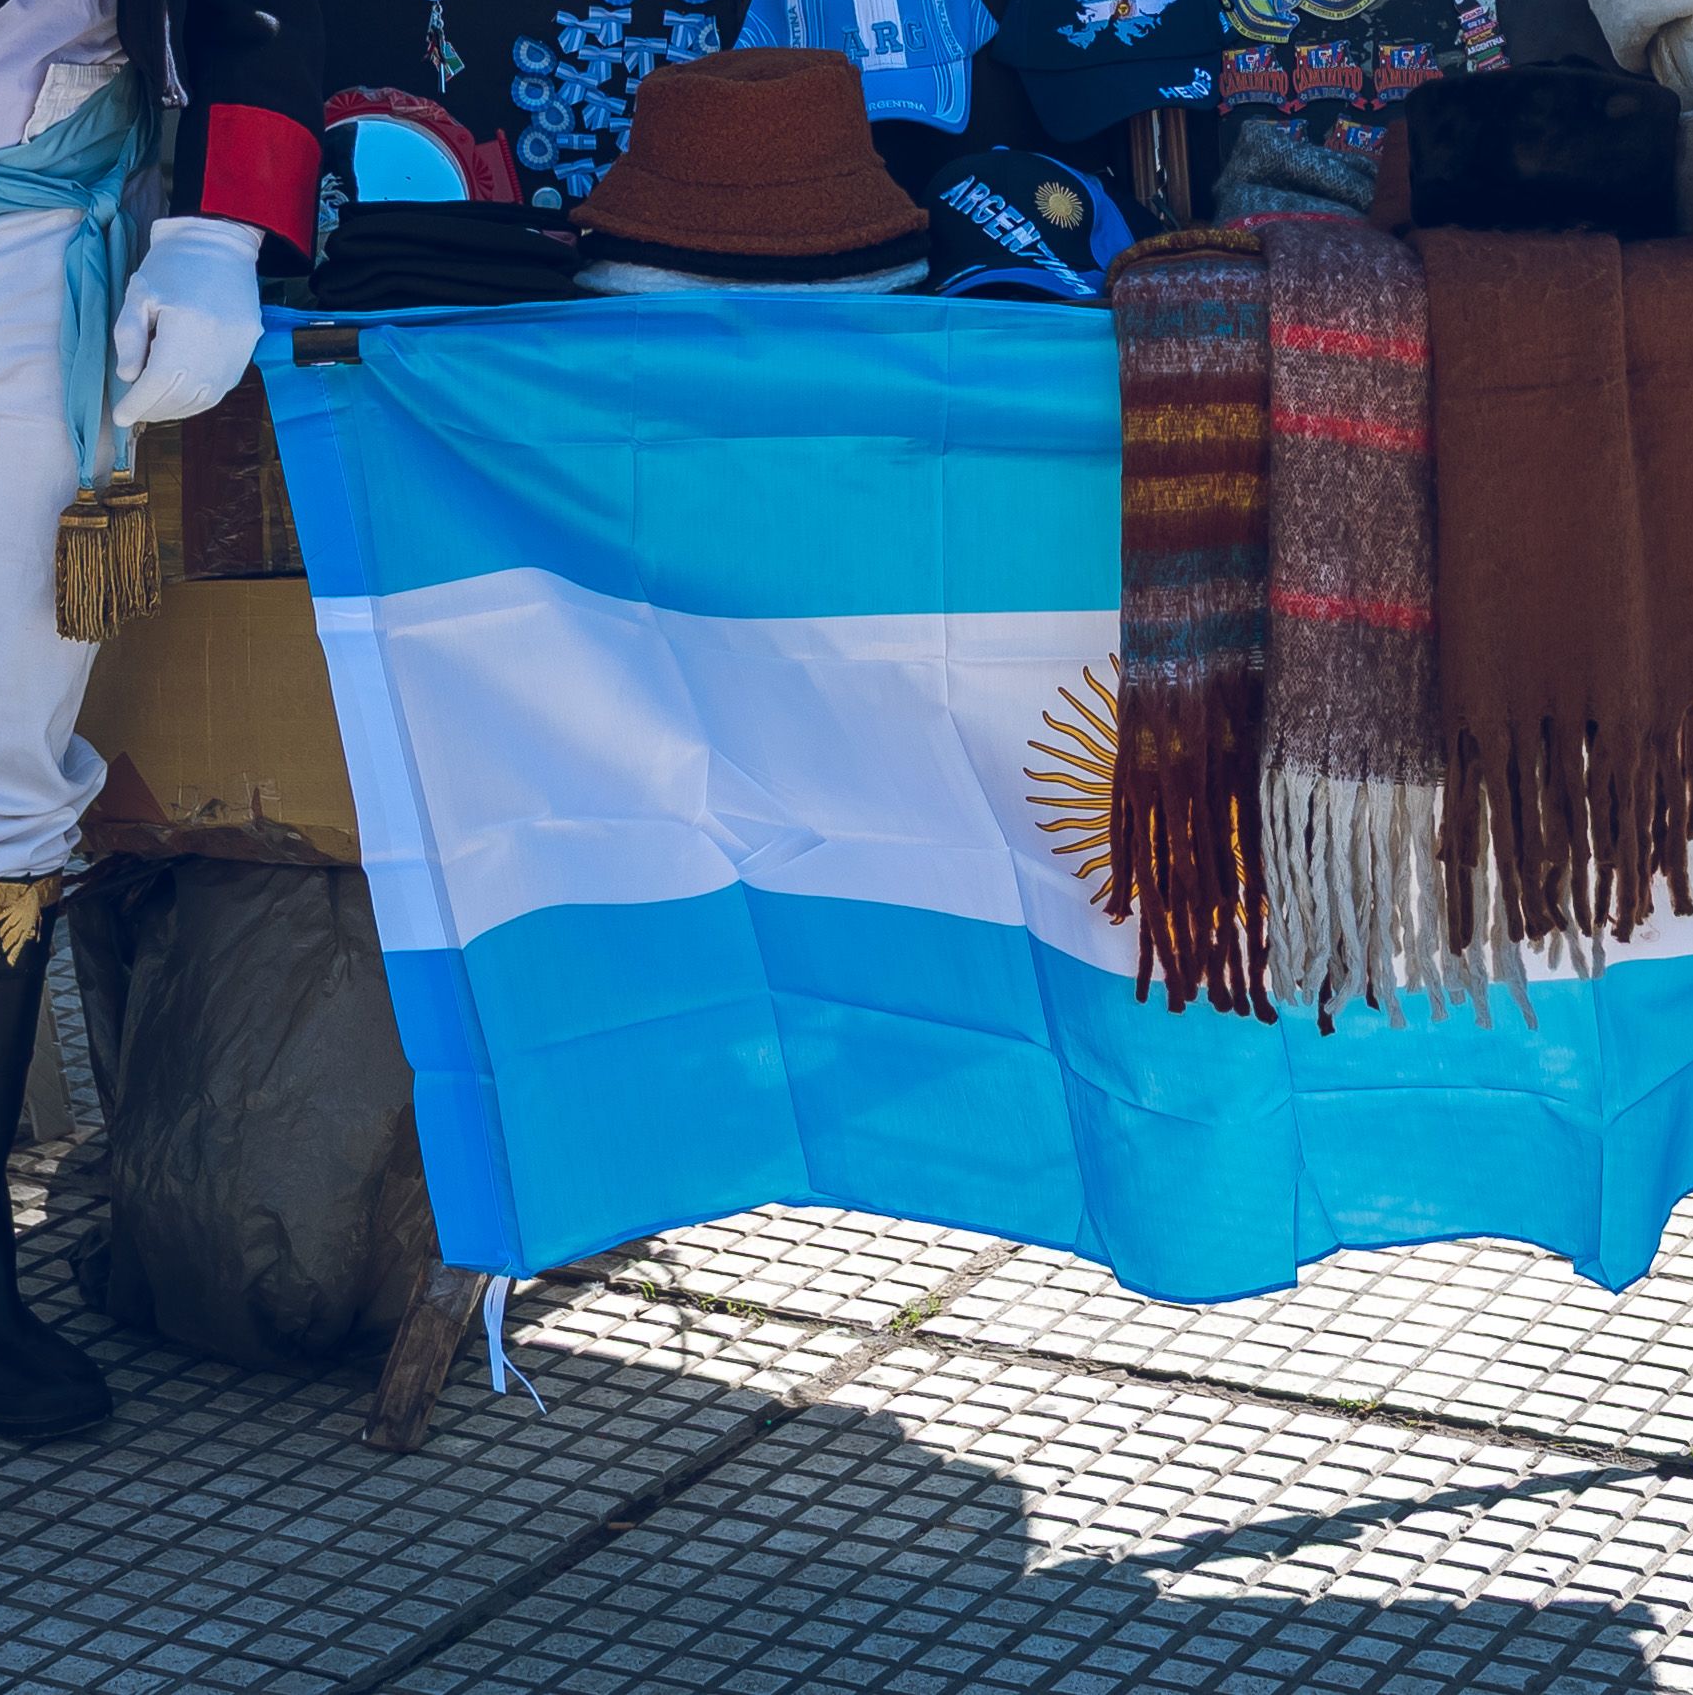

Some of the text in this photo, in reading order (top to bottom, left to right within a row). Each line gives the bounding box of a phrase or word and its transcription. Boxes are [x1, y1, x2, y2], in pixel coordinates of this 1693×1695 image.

[842, 21, 927, 58] ARG
[1158, 67, 1212, 99] HEROES
[1219, 69, 1289, 97] CAMINITO
[1293, 67, 1363, 95] CAMINITO
[869, 100, 927, 113] RGENTINA
[939, 174, 1097, 295] ARGENTINA
